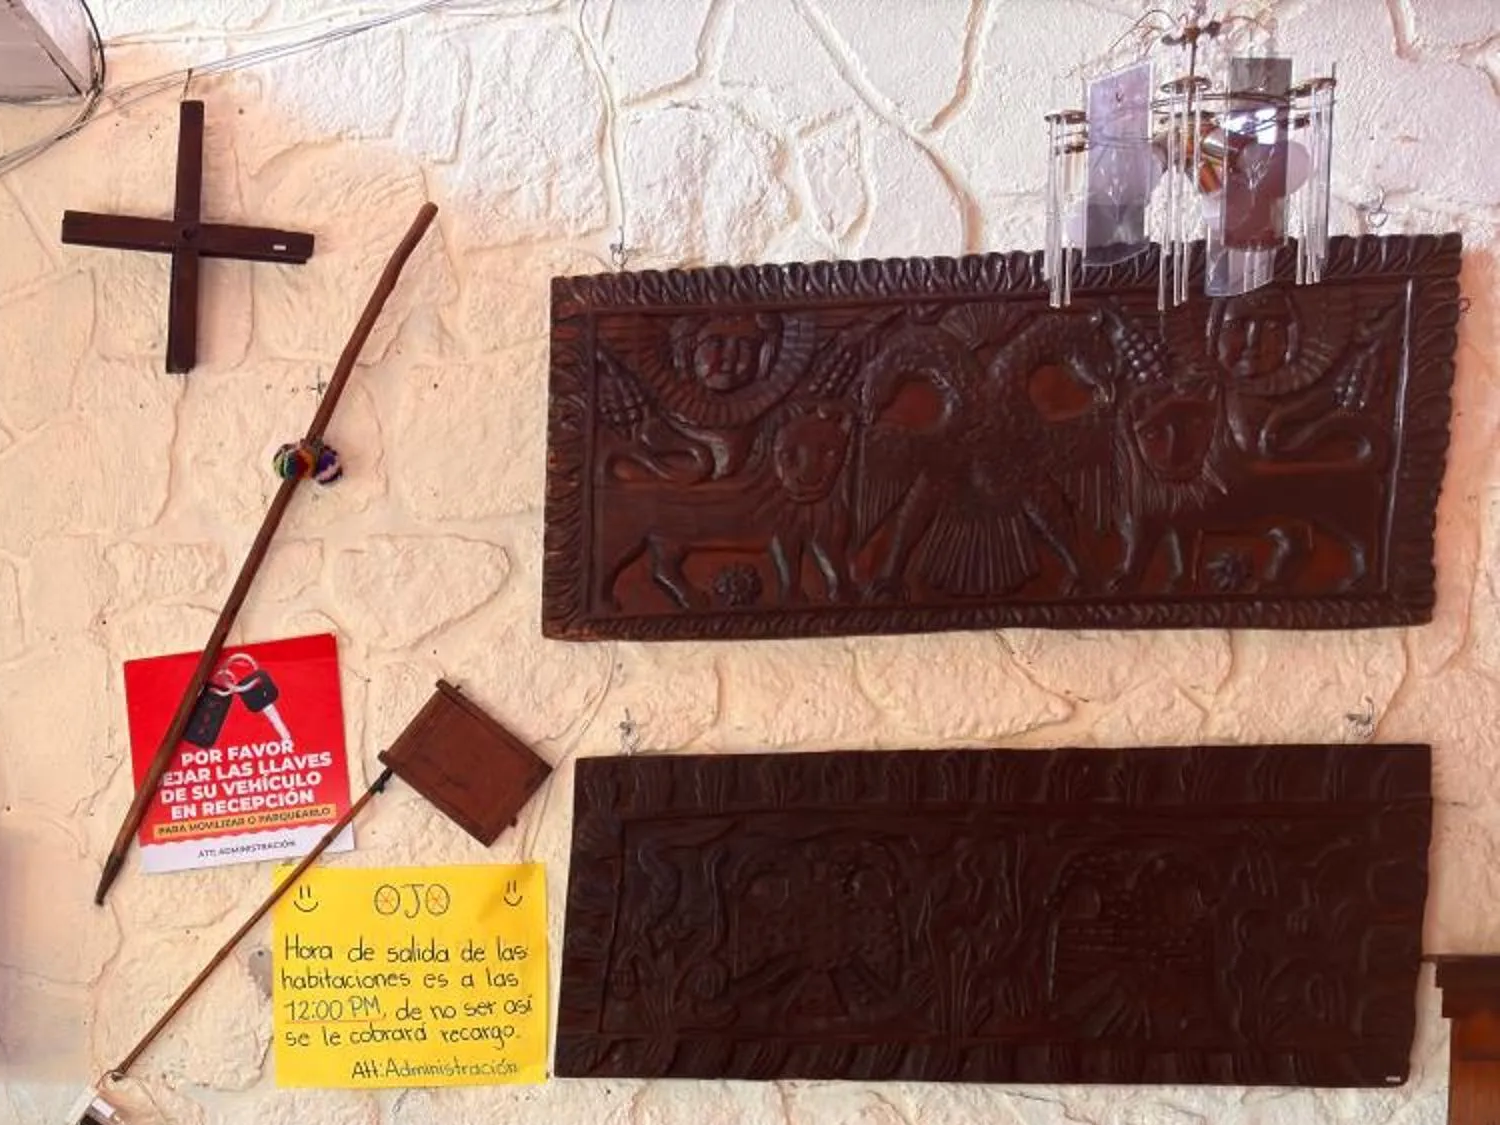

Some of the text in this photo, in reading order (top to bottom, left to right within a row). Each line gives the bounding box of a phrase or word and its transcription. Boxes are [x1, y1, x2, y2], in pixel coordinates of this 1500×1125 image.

[181, 740, 294, 767] POR FAVOR
[162, 752, 333, 787] EJAR LAS LLAVES
[160, 771, 322, 804] DE SU VEHÍCULO
[171, 787, 315, 820] EN RECEPCIÓN
[158, 824, 187, 835] PARA
[247, 815, 257, 825] O
[373, 883, 451, 919] OJO
[284, 933, 528, 964] Hora de salida de las
[280, 965, 519, 990] habitaciones es a las
[284, 998, 344, 1021] 12:00
[395, 997, 422, 1021] de
[430, 1003, 457, 1020] no
[463, 1001, 497, 1018] ser
[503, 994, 534, 1015] así
[285, 1031, 310, 1047] se
[321, 1026, 342, 1046] le
[350, 1022, 428, 1045] cobrará
